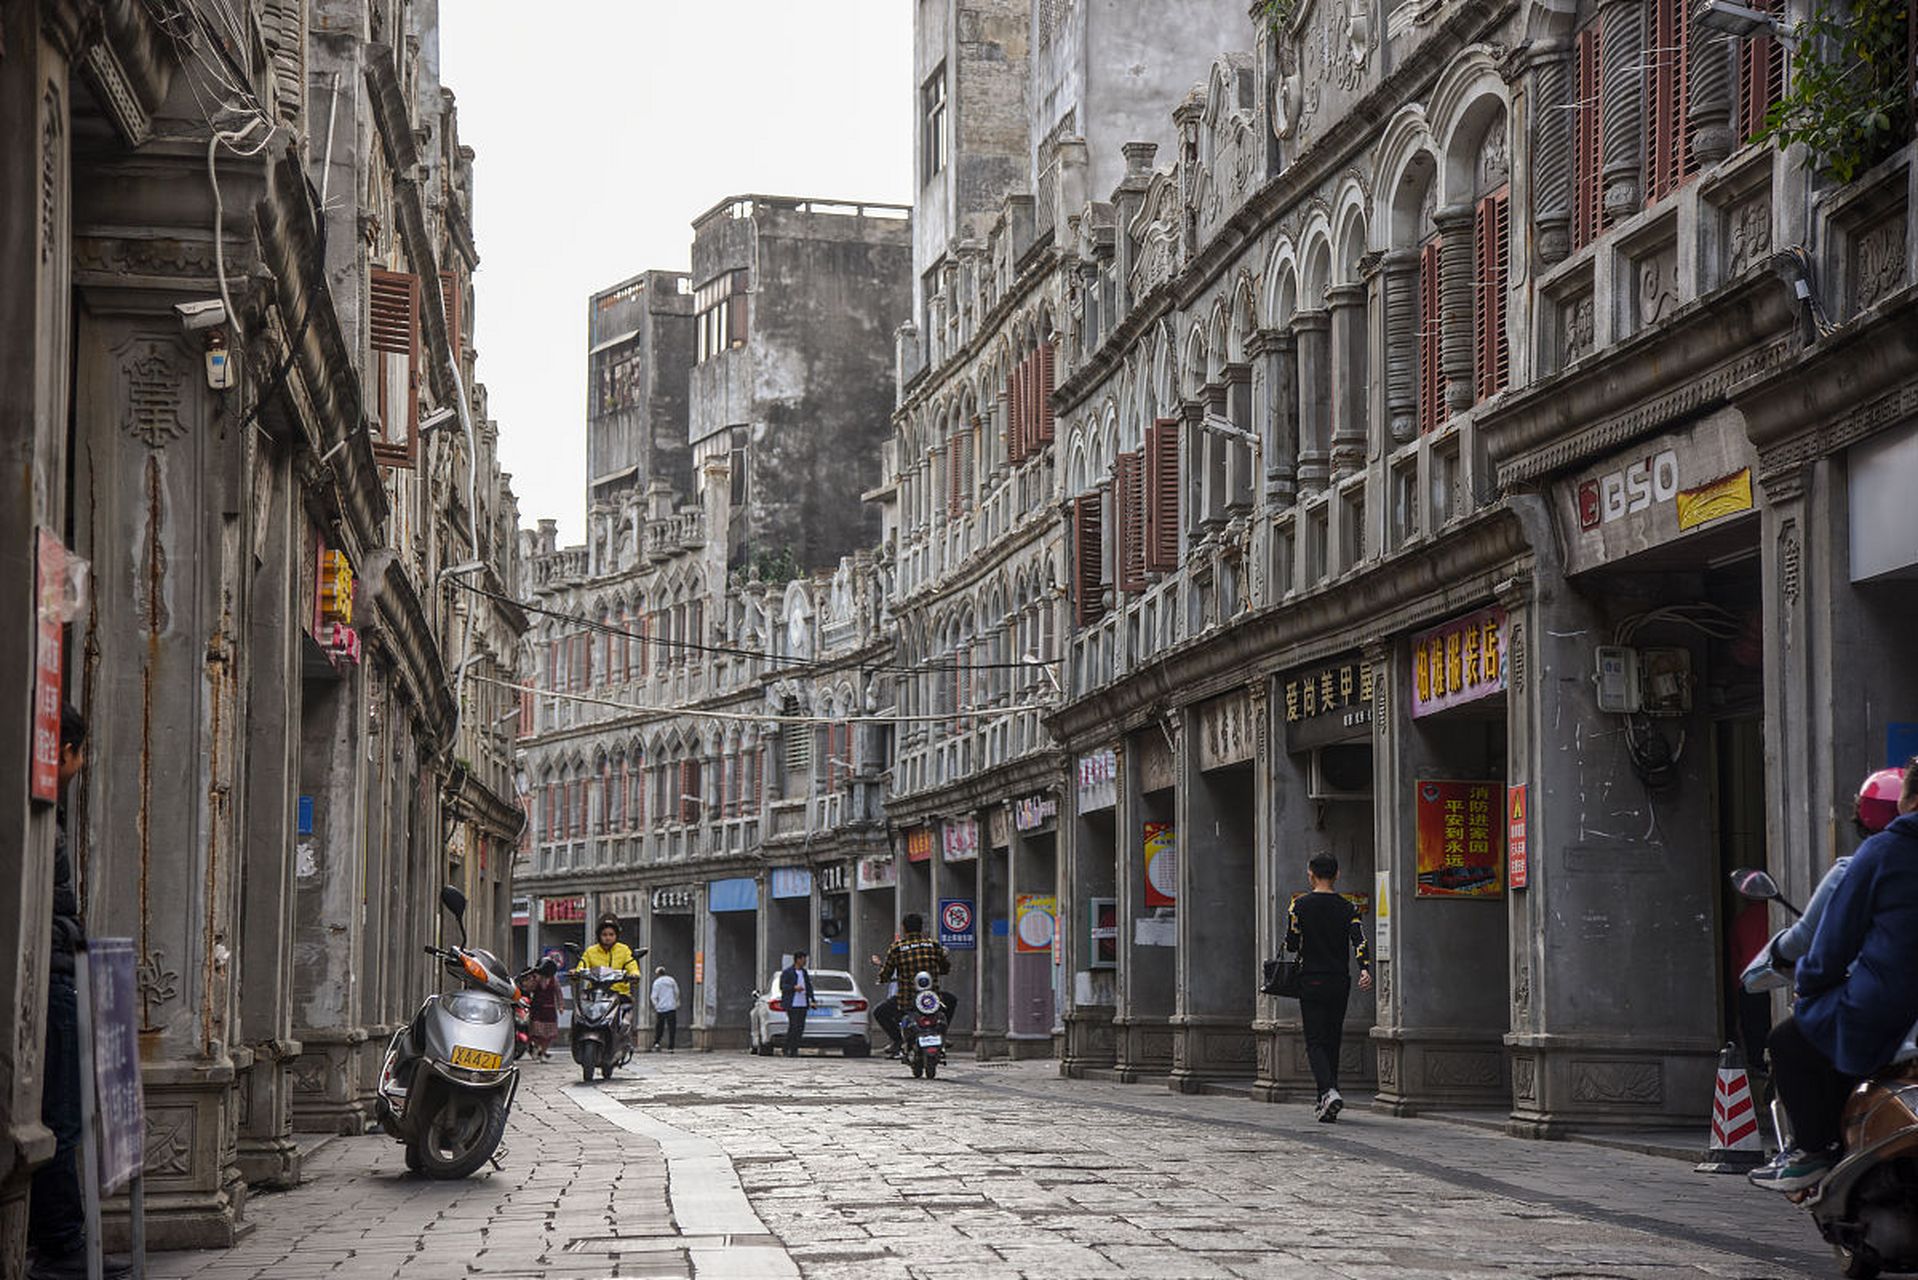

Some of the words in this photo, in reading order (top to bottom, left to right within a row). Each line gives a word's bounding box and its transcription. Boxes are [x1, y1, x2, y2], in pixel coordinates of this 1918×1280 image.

[1445, 799, 1464, 867] 平安到永远
[1469, 786, 1488, 853] 消防进家园
